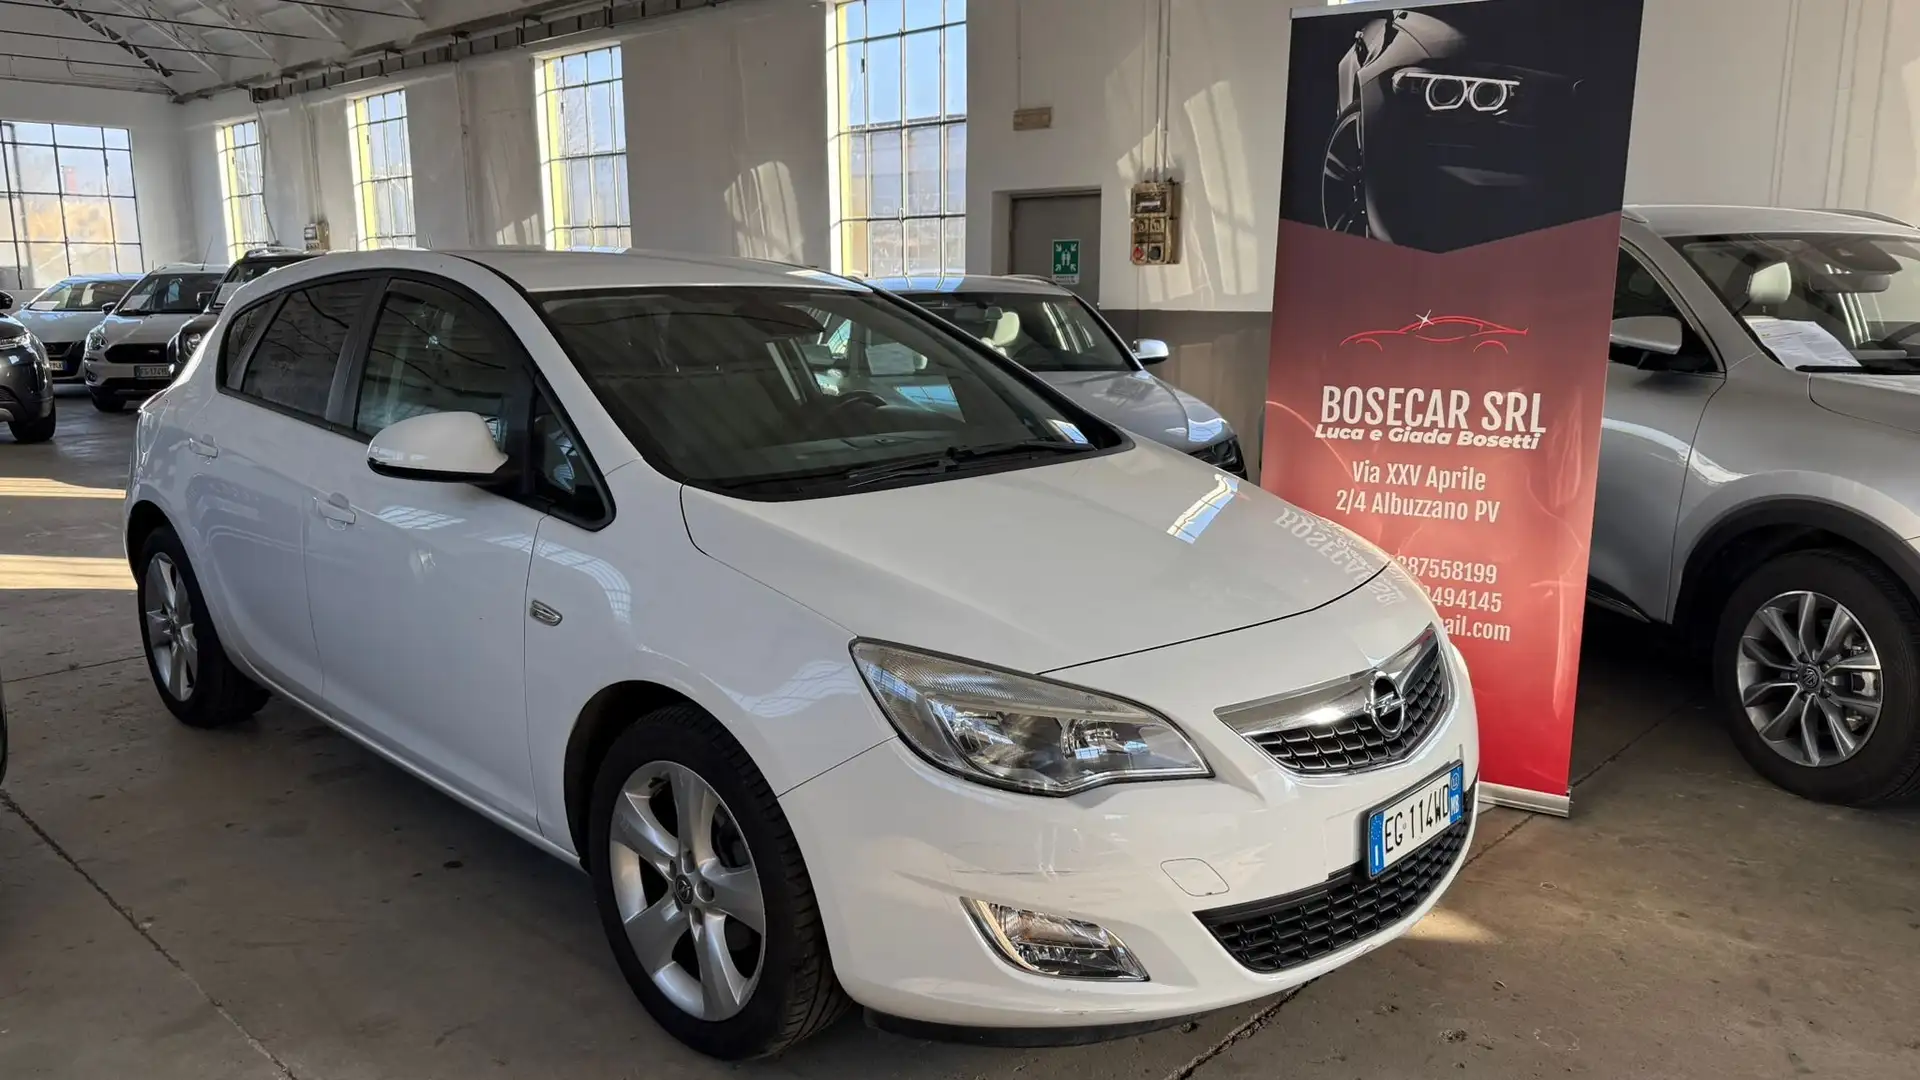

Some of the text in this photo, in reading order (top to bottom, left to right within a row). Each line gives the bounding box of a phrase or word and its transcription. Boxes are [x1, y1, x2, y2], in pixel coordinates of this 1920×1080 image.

[1321, 385, 1546, 433] BOSECAR SRL
[1315, 423, 1540, 450] Luca e Giada Bosetti
[1352, 459, 1486, 494] Via XXV Aprile
[1335, 488, 1501, 523] 2/4 Albuzzano PV
[1442, 614, 1512, 642] ail.com
[1384, 811, 1404, 855] EG
